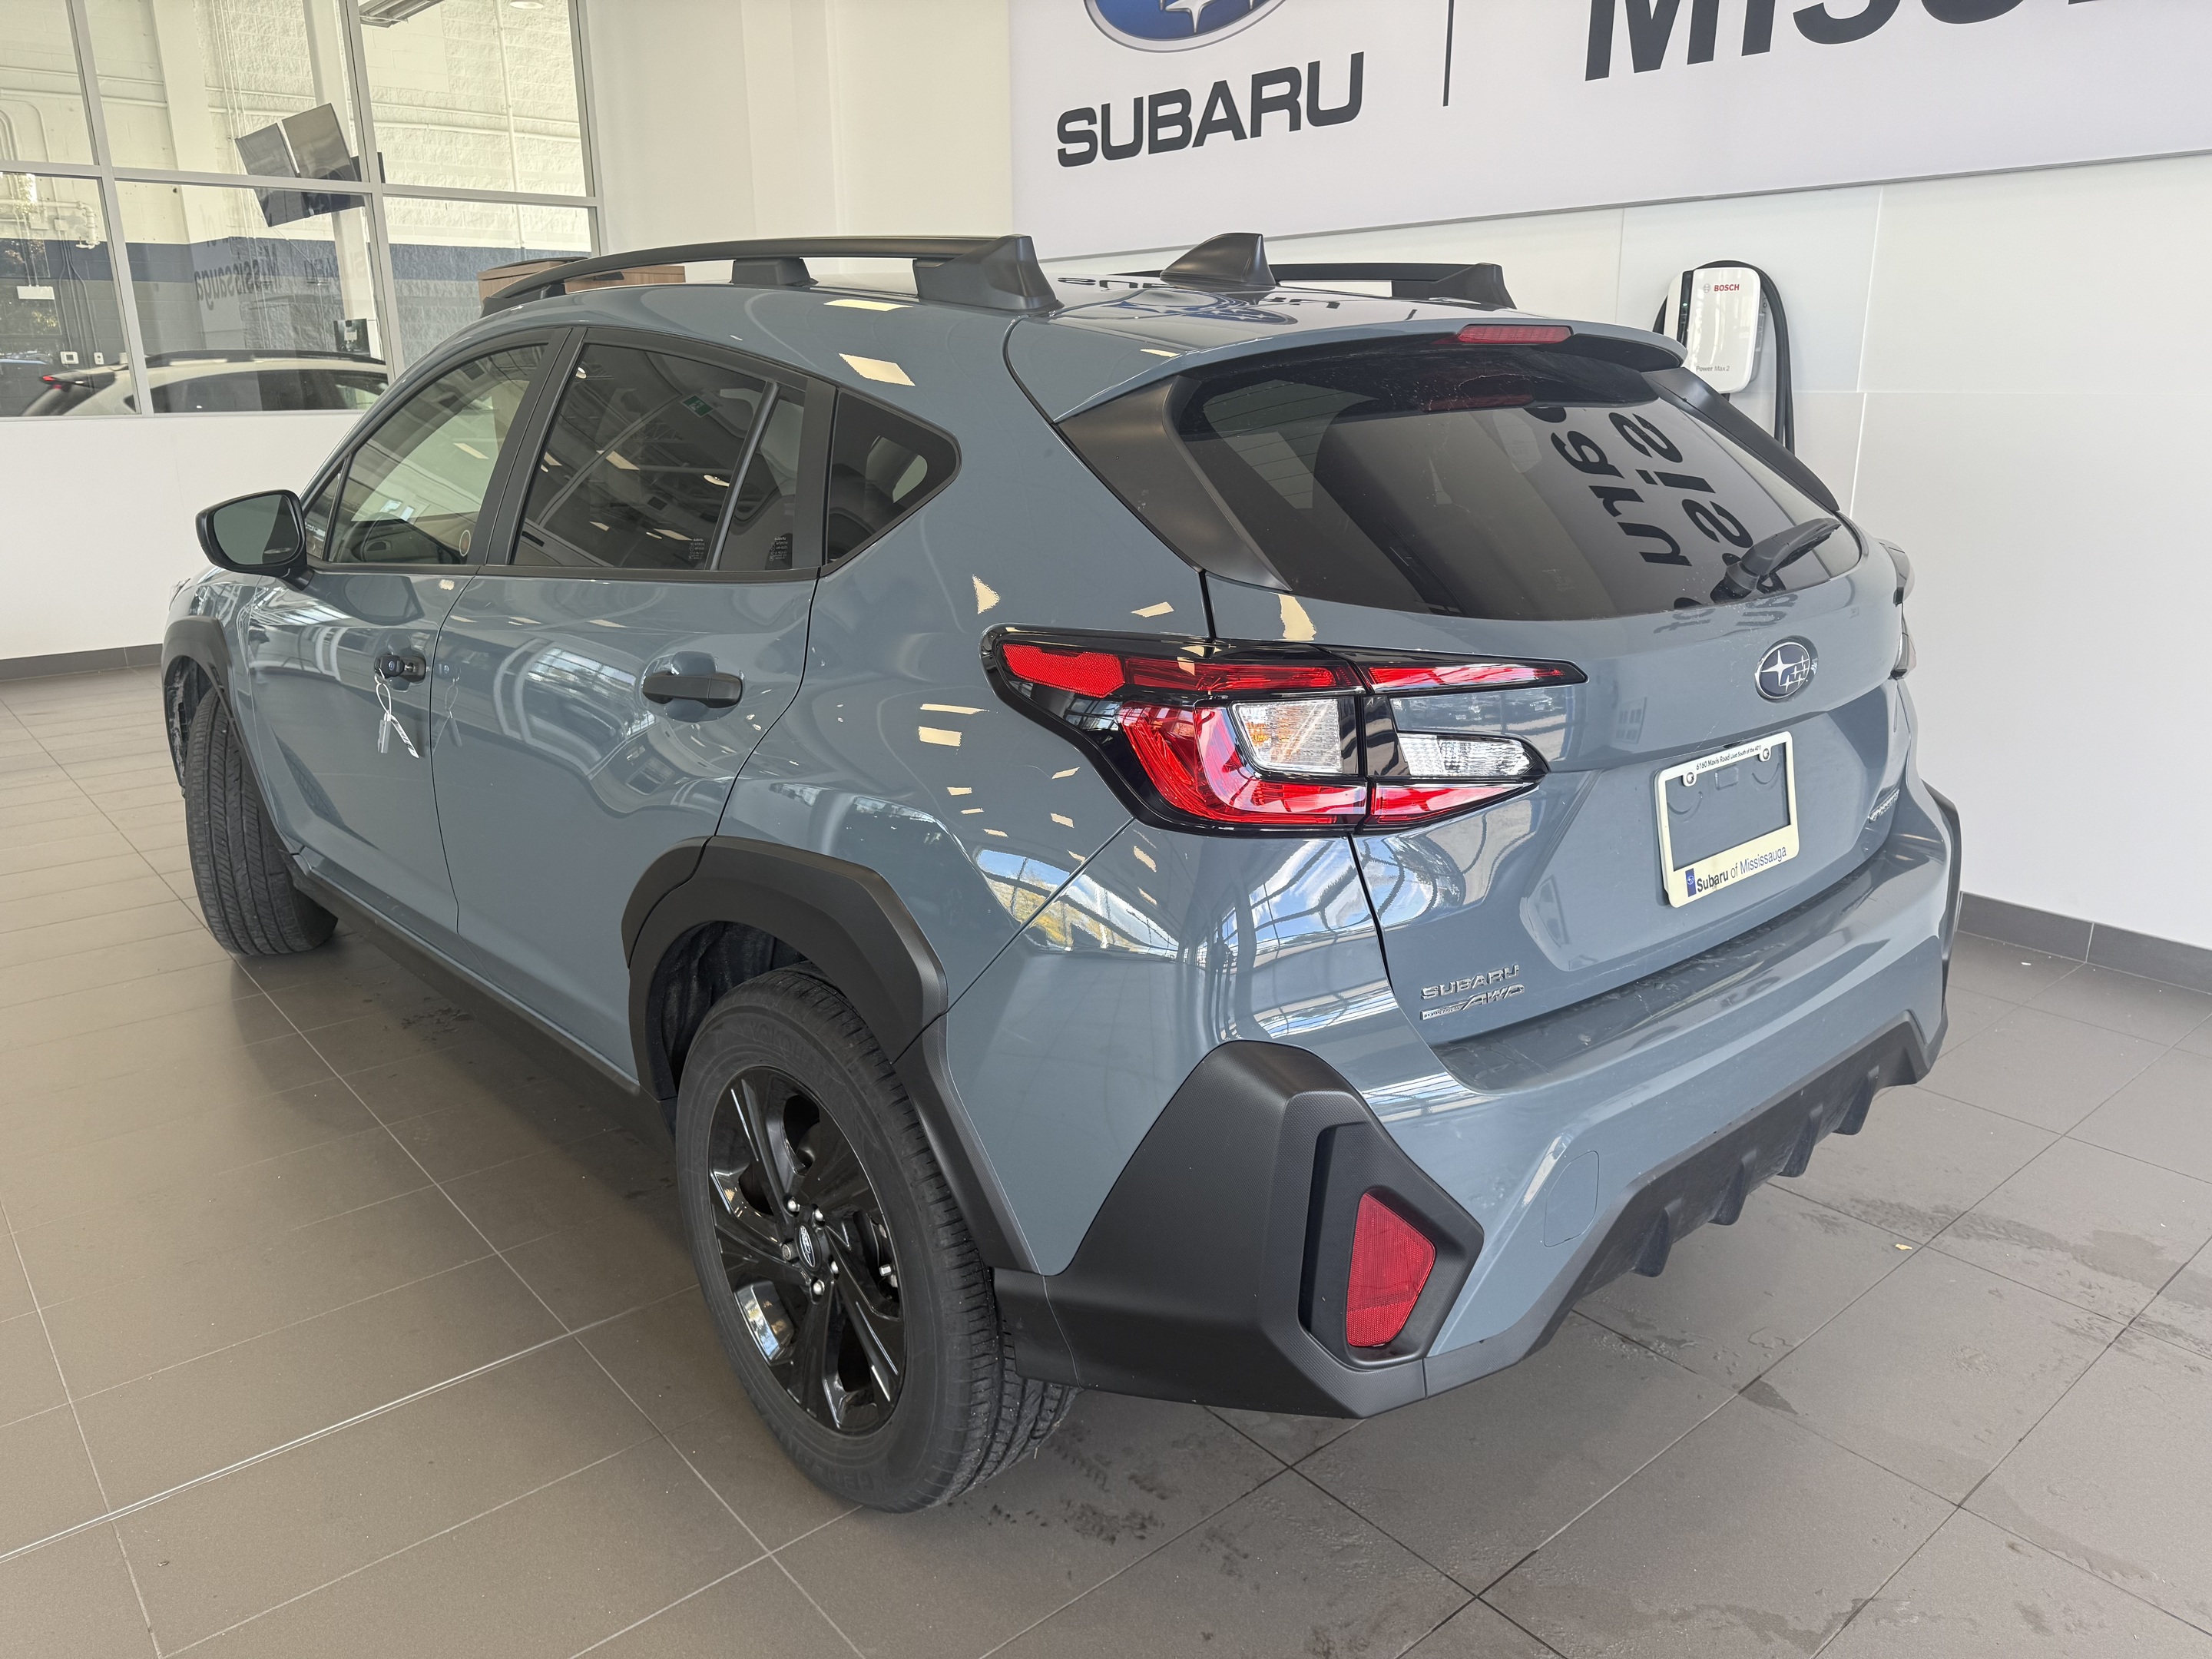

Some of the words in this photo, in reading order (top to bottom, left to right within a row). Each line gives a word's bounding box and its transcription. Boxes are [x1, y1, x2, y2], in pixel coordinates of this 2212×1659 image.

[1057, 51, 1364, 167] SUBARU
[1714, 283, 1740, 292] BOSCH
[1696, 760, 1707, 770] 6160
[1707, 757, 1720, 767] Mavis
[1720, 753, 1730, 763] Road
[1697, 869, 1729, 892] Subaru
[1730, 863, 1739, 879] of
[1740, 846, 1787, 875] Mississauga
[1421, 964, 1519, 999] SUBARU
[1462, 983, 1525, 1010] AWD
